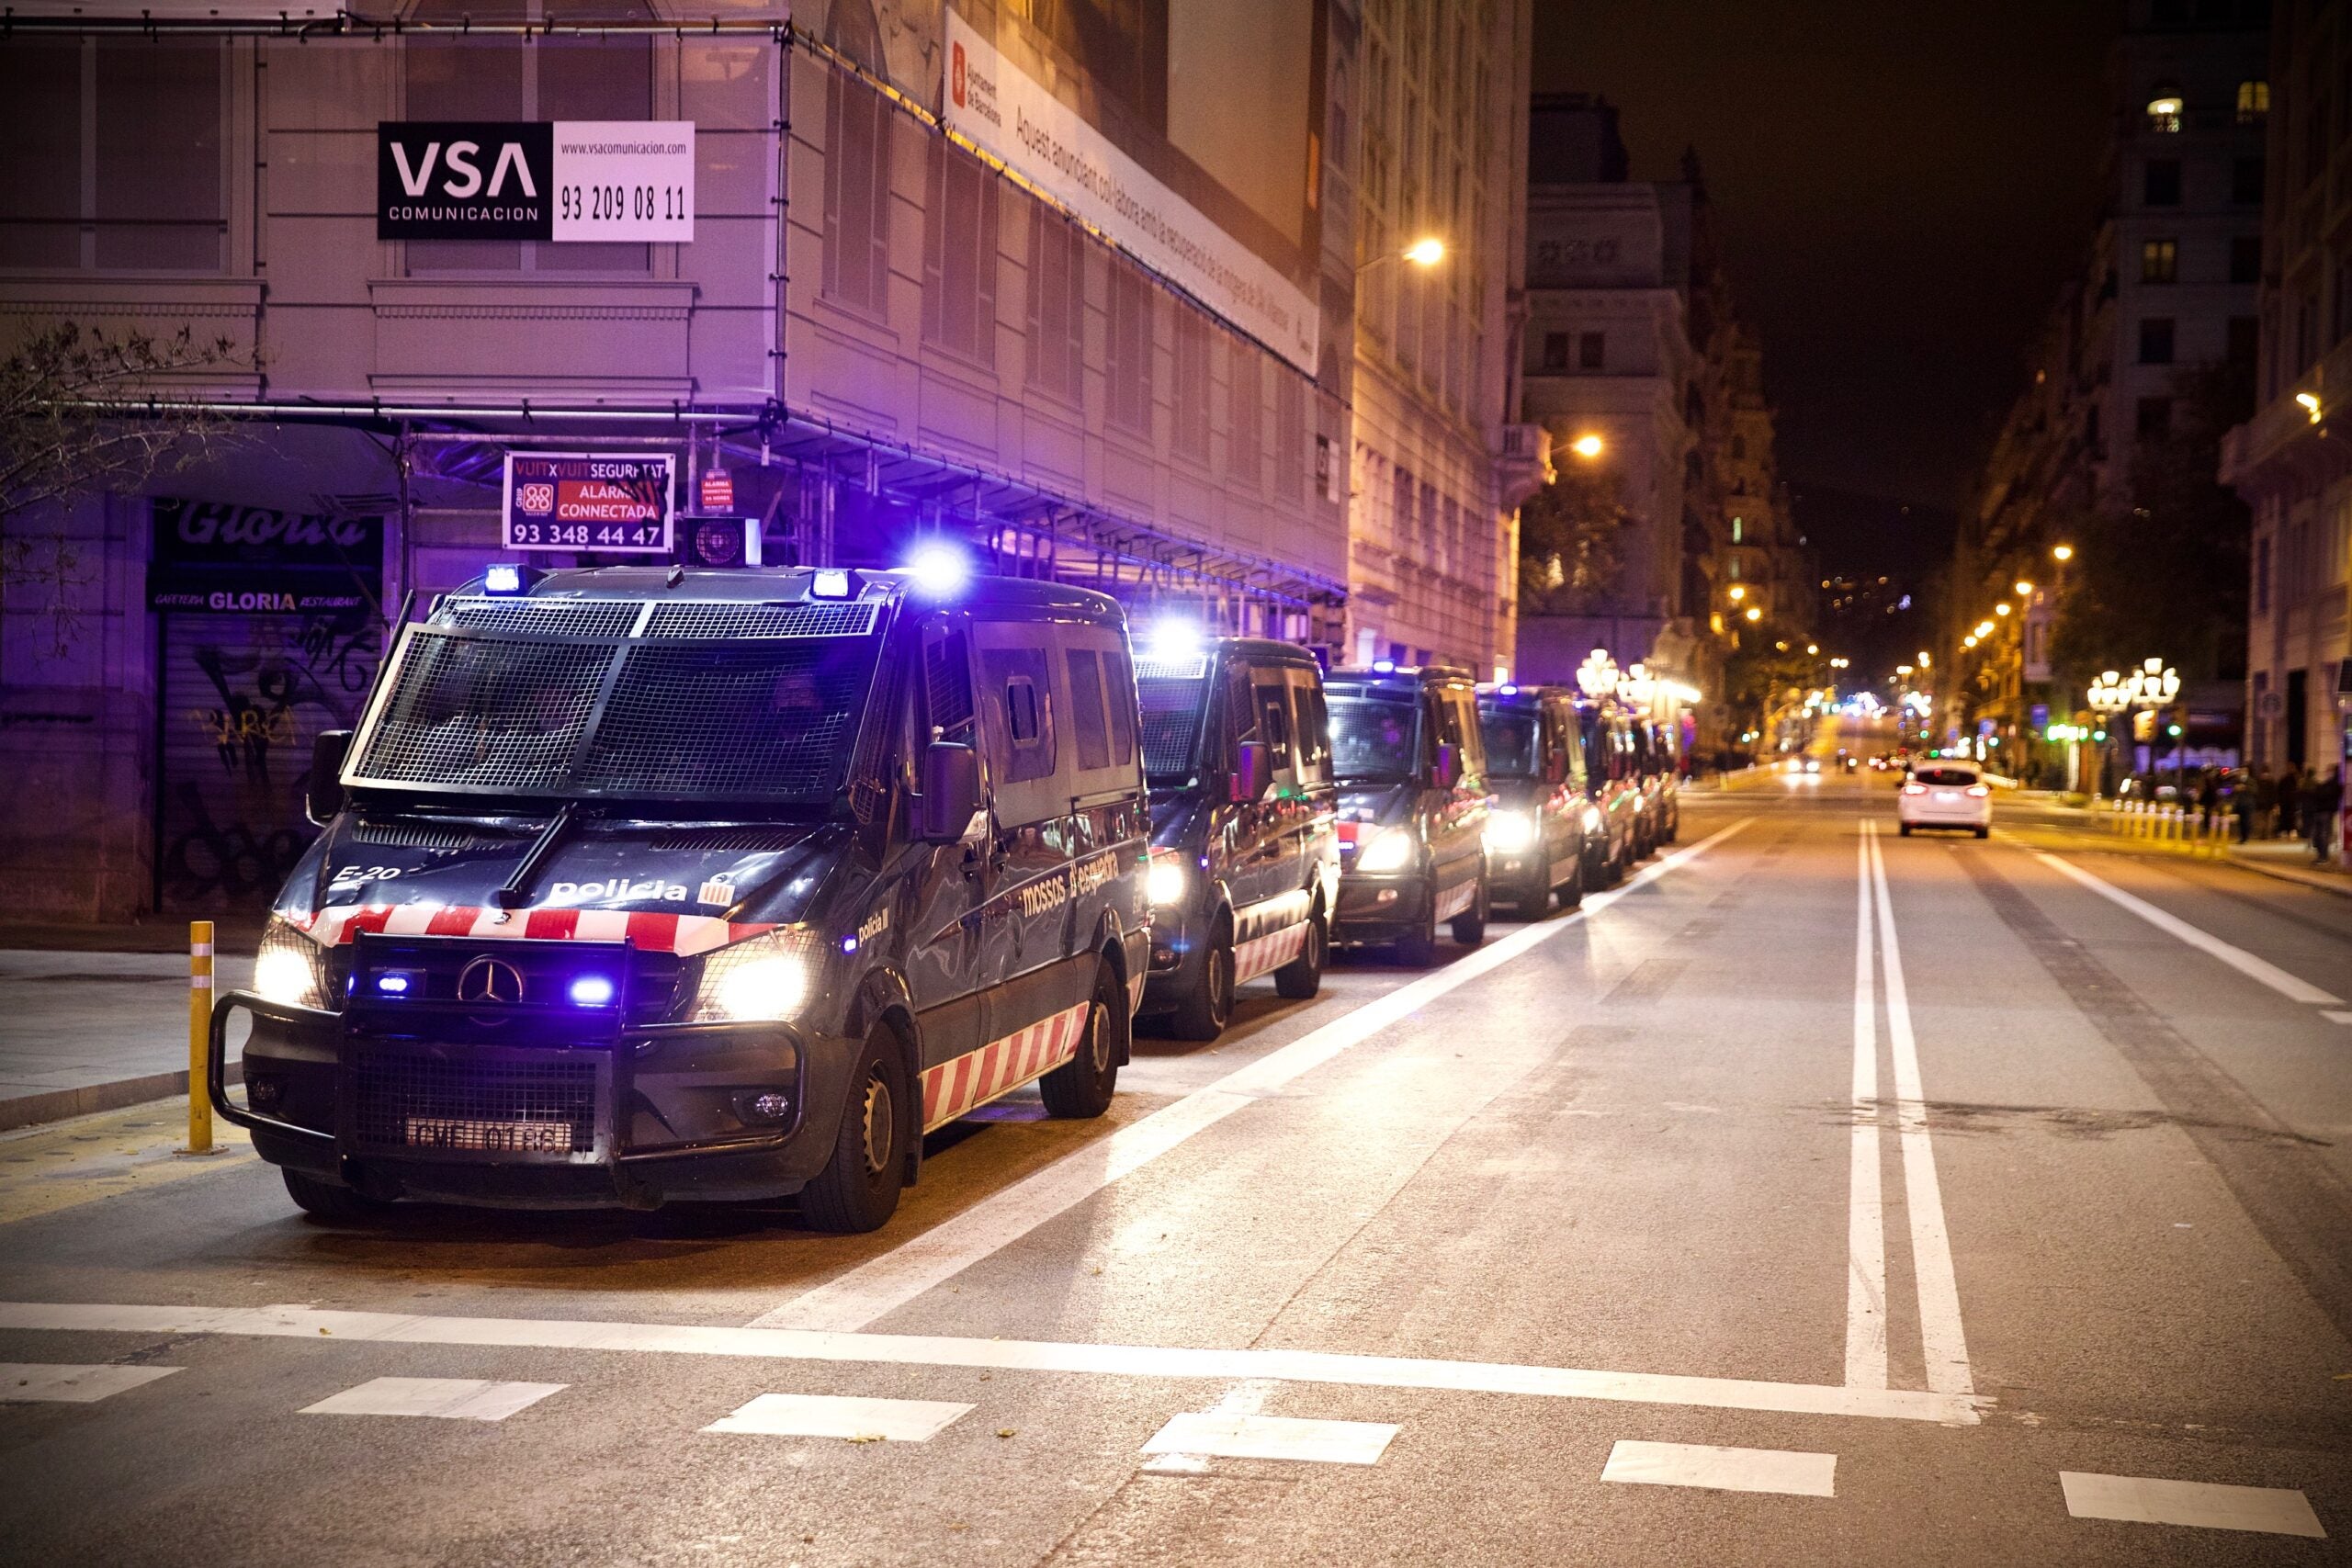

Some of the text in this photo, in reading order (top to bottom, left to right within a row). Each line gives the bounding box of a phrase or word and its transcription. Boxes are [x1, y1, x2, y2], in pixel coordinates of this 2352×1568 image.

[560, 141, 687, 155] www.vsacomunicacion.com
[1016, 103, 1051, 163] Aquest
[1052, 141, 1098, 196] anunciant
[390, 140, 537, 198] VSA
[389, 206, 539, 221] COMUNICACION
[561, 186, 685, 220] 93 209 08 11
[579, 484, 636, 500] ALARM
[559, 503, 657, 519] CONNECTADA
[514, 524, 661, 546] 93 348 44 47
[209, 592, 296, 611] GLORIA
[333, 865, 402, 882] E-20
[1022, 848, 1120, 918] mossos d'esquadra
[549, 879, 688, 902] policia
[858, 911, 882, 948] policia
